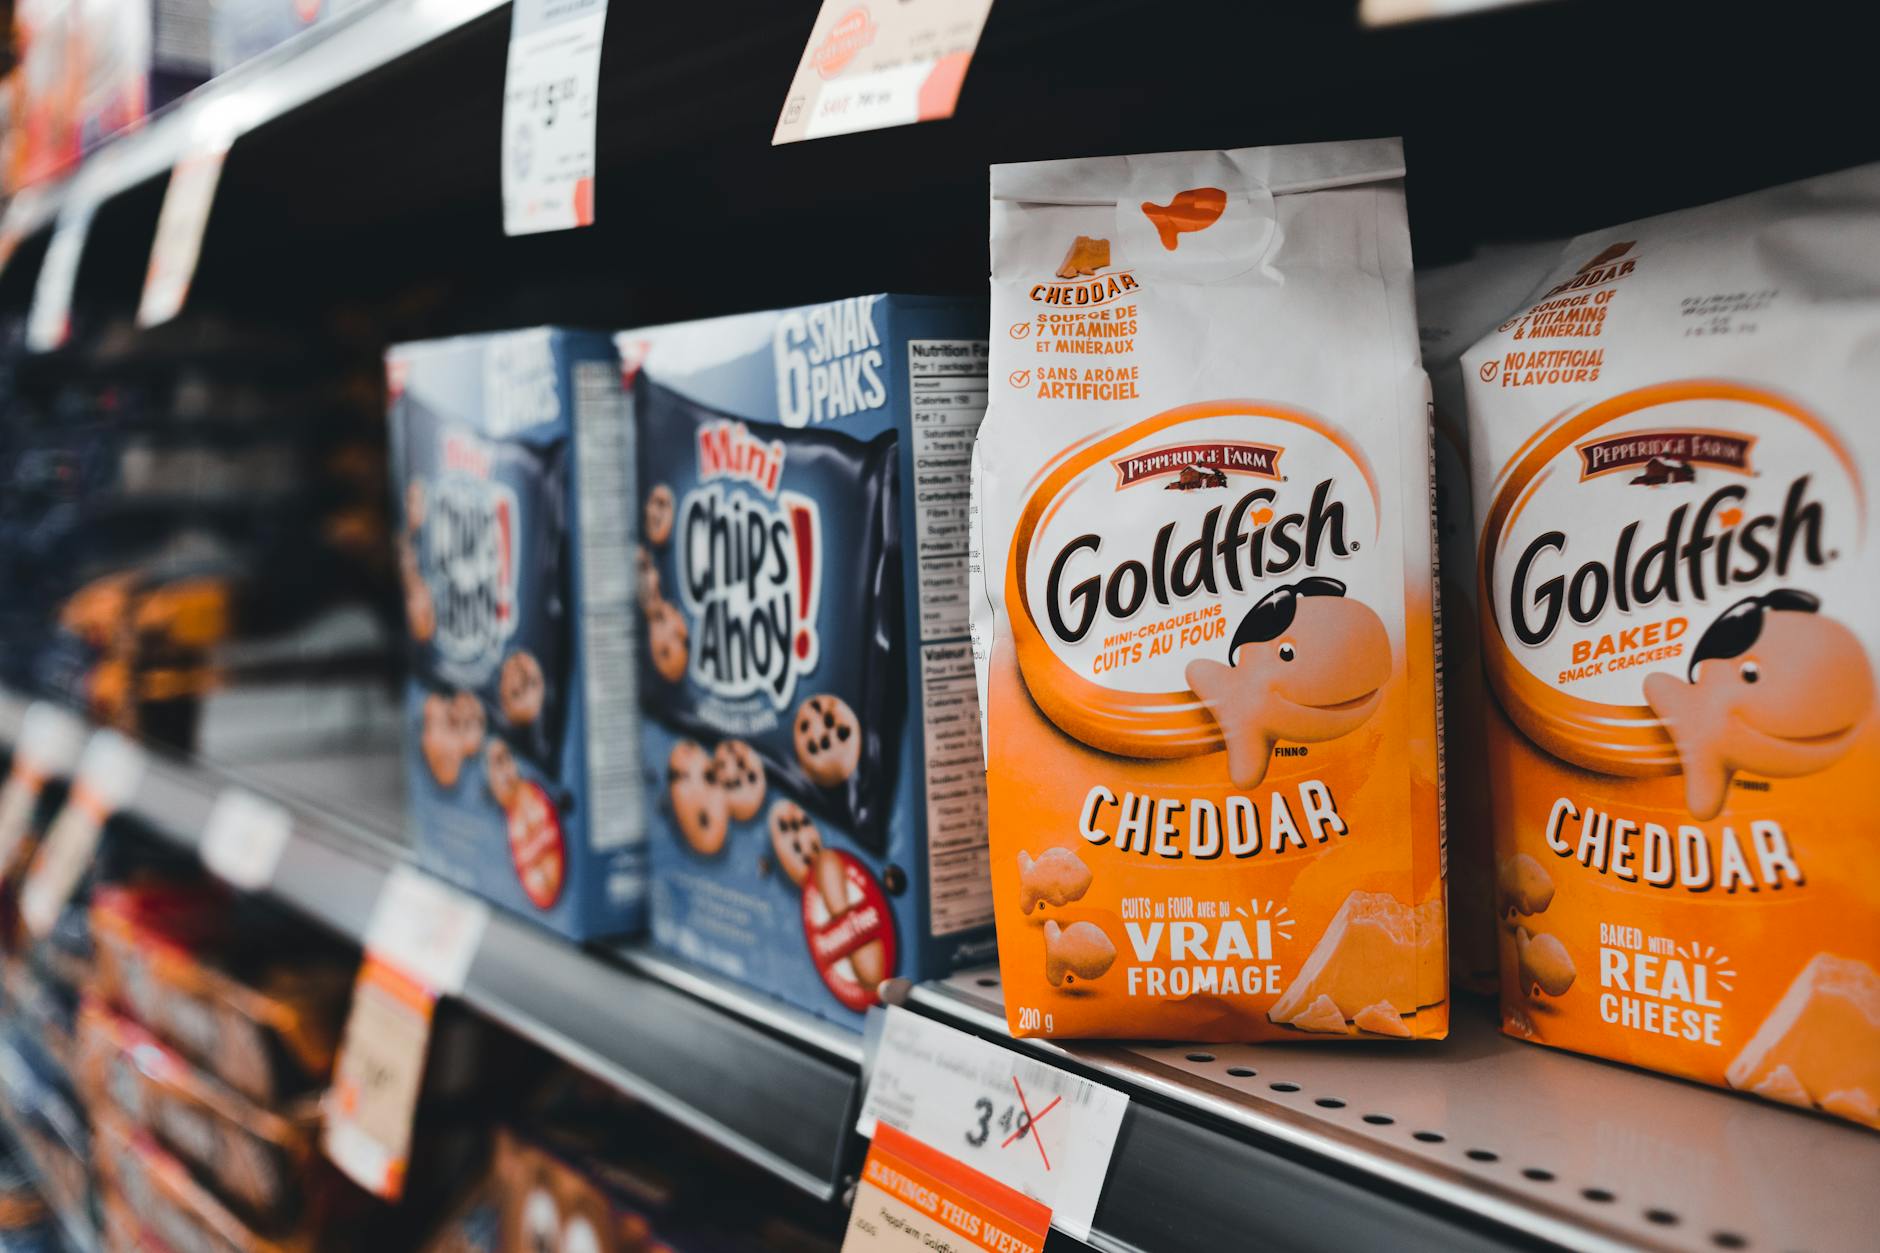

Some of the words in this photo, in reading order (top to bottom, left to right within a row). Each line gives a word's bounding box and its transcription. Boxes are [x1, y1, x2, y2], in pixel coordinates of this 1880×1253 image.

[1029, 273, 1139, 305] CHEDDAR
[1542, 260, 1636, 300] DDAR
[1037, 309, 1110, 322] SOURCE
[1115, 305, 1137, 320] DE
[1529, 293, 1592, 314] SOURCE
[1595, 289, 1616, 305] OF
[1532, 306, 1607, 327] VITAMINS
[1036, 324, 1045, 336] 7
[1050, 320, 1137, 337] VITAMINES
[1036, 341, 1051, 352] ET
[1055, 337, 1134, 354] MINÉRAUX
[1513, 327, 1525, 340] &
[1528, 323, 1602, 339] MINERALS
[774, 312, 811, 428] 6
[808, 295, 880, 365] SNAK
[912, 344, 970, 357] Nutrition
[1504, 352, 1525, 370] NO
[1526, 348, 1604, 369] ARTIFICIAL
[811, 349, 886, 424] PAKS
[1037, 367, 1078, 380] SANS
[1084, 366, 1138, 381] ARÔME
[1037, 382, 1140, 400] ARTIFICIEL
[1502, 368, 1600, 387] FLAVOURS
[915, 396, 951, 405] Calories
[700, 426, 782, 492] Mini
[684, 494, 790, 604] Chips
[1511, 472, 1824, 645] Goldfish
[1103, 604, 1222, 648] MINI-CRAQUELINS
[1572, 617, 1688, 664] BAKED
[925, 647, 966, 660] Valeur
[1093, 642, 1142, 674] CUITS
[1149, 634, 1173, 659] AU
[1180, 618, 1226, 649] FOUR
[1558, 662, 1603, 684] SNACK
[1608, 643, 1683, 672] CRACKERS
[1078, 779, 1349, 859] CHEDDAR
[1545, 797, 1806, 894] CHEDDAR
[1121, 897, 1151, 919] CUITS
[1155, 902, 1165, 919] AU
[1167, 896, 1194, 919] FOUR
[1197, 902, 1217, 919] AVEC
[1219, 901, 1231, 918] DU
[1123, 919, 1273, 962] VRAI
[1600, 922, 1643, 951] BAKED
[1648, 936, 1675, 957] WITH
[1127, 965, 1282, 996] FROMAGE
[1600, 947, 1722, 1009] REAL
[1018, 1007, 1041, 1030] 200
[1044, 1013, 1053, 1033] g
[1600, 993, 1722, 1047] CHEESE
[966, 1097, 993, 1147] 3
[867, 1158, 941, 1213] SAVINGS
[941, 1199, 982, 1237] THIS
